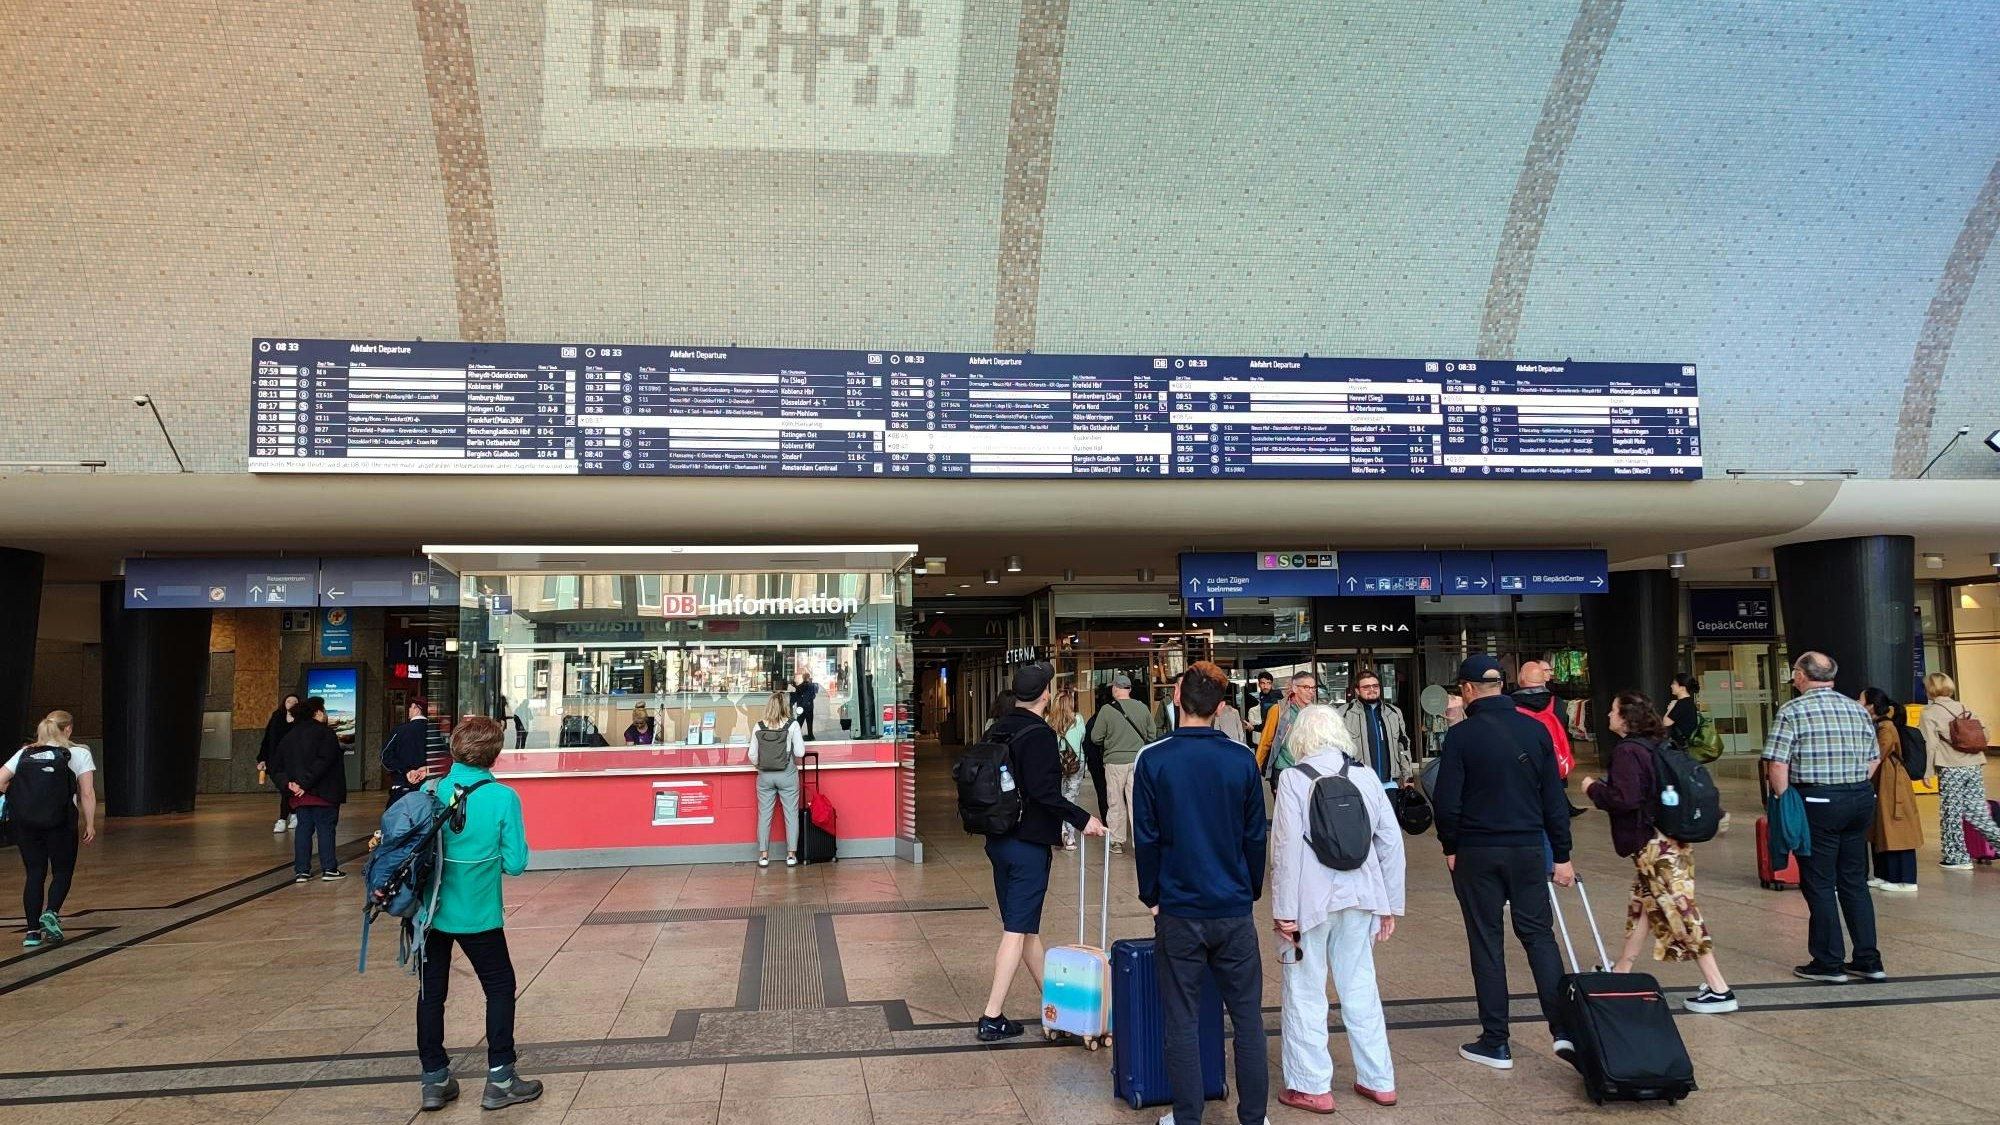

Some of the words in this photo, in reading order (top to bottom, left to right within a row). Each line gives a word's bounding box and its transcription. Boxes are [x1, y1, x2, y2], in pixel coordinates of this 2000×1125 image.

[350, 344, 377, 353] Abfahrt
[379, 345, 411, 354] Departure
[696, 351, 727, 360] Departure
[994, 358, 1022, 366] Departure
[1538, 365, 1564, 373] Departure
[468, 372, 528, 380] Rheydt-Odenkirchen
[790, 377, 807, 385] (Sieg)
[467, 406, 493, 414] Ratingen
[467, 428, 518, 436] Mönchengladbach
[1216, 576, 1228, 584] den
[1230, 576, 1250, 585] Zügen
[710, 594, 858, 615] Information
[1208, 598, 1215, 611] 1
[1324, 624, 1410, 632] ETERNA
[1697, 620, 1768, 631] GepäckCenter
[404, 640, 412, 658] 1
[1006, 646, 1034, 664] ETERNA
